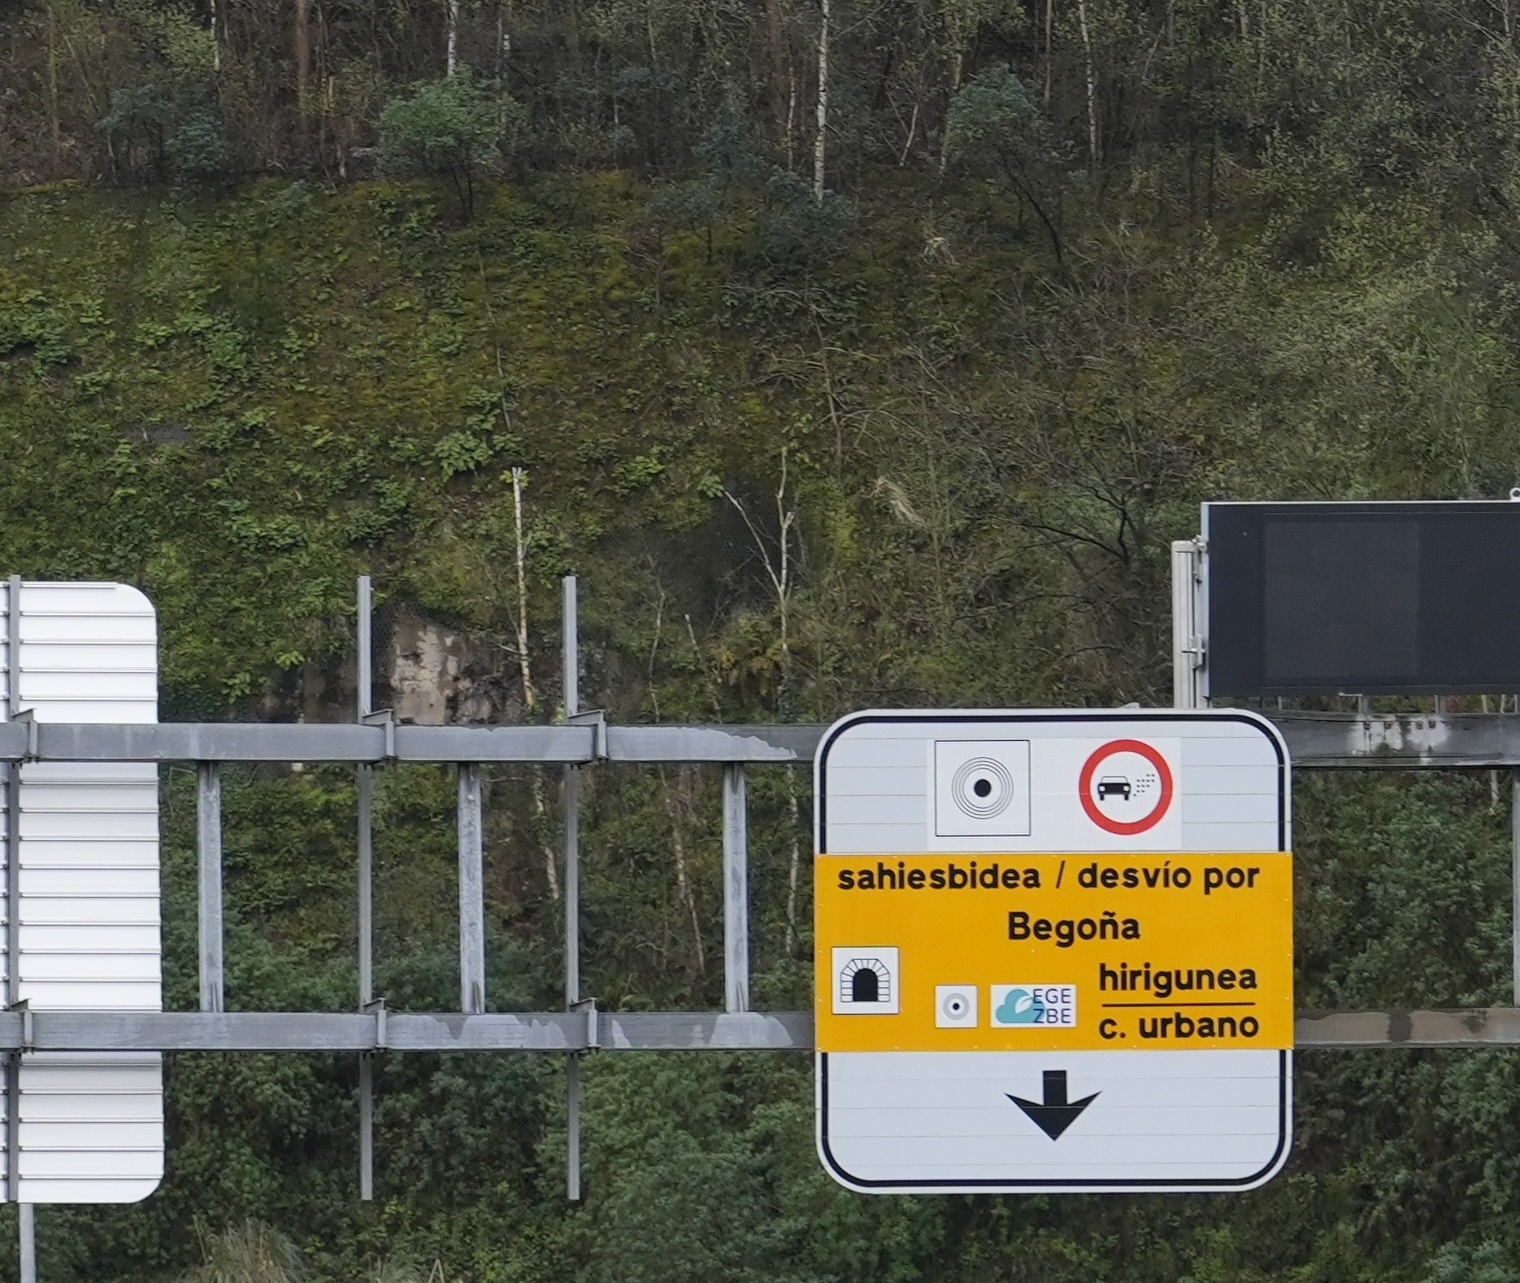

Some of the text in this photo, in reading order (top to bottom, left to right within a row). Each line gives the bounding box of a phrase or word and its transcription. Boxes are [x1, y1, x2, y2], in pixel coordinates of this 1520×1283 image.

[837, 861, 1042, 890] sahiesbidea
[1077, 861, 1192, 889] desvío
[1203, 868, 1261, 896] por
[1008, 911, 1141, 948] Begoña
[1099, 962, 1258, 998] hirigunea
[1031, 988, 1072, 1005] EGE
[1031, 1007, 1072, 1025] ZBE
[1099, 1011, 1260, 1040] c. urbano
